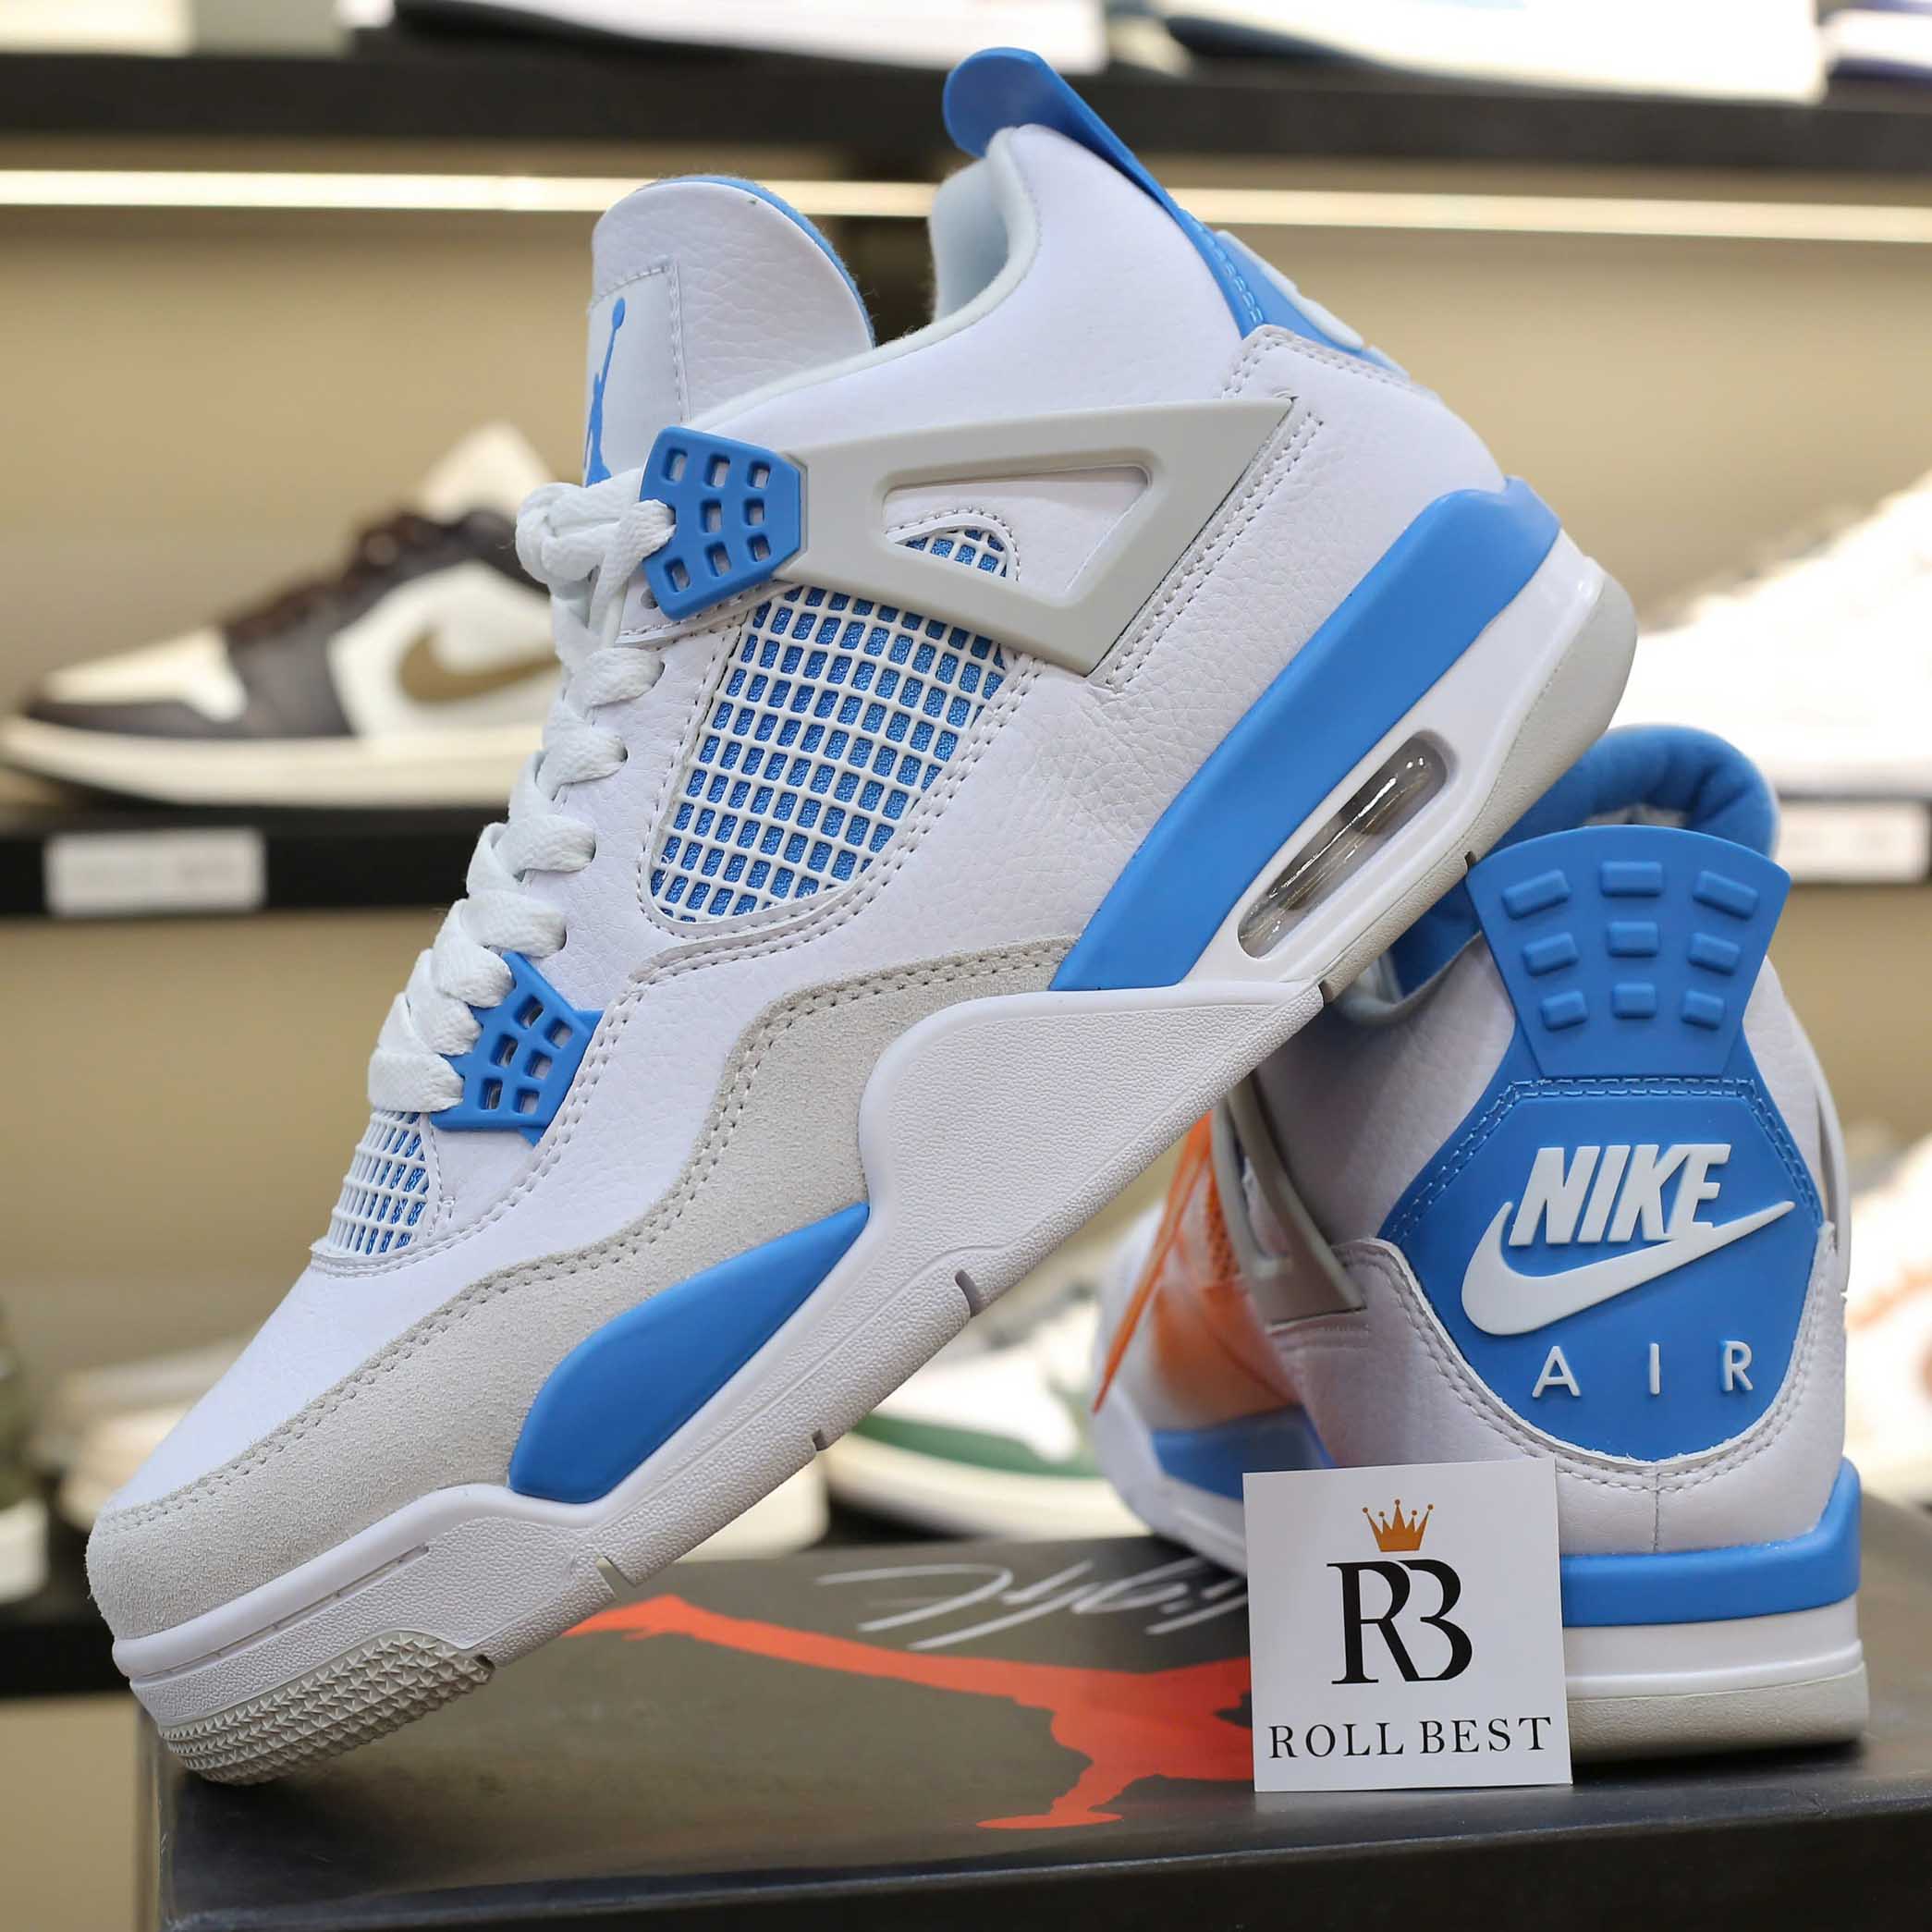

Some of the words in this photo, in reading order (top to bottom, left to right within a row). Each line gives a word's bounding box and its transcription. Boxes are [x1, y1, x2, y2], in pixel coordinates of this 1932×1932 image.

[1508, 1143, 1731, 1246] NIKE
[1532, 1339, 1754, 1399] AIR
[1327, 1559, 1473, 1684] RB
[1268, 1722, 1405, 1759] ROLL
[1419, 1716, 1552, 1755] BEST
